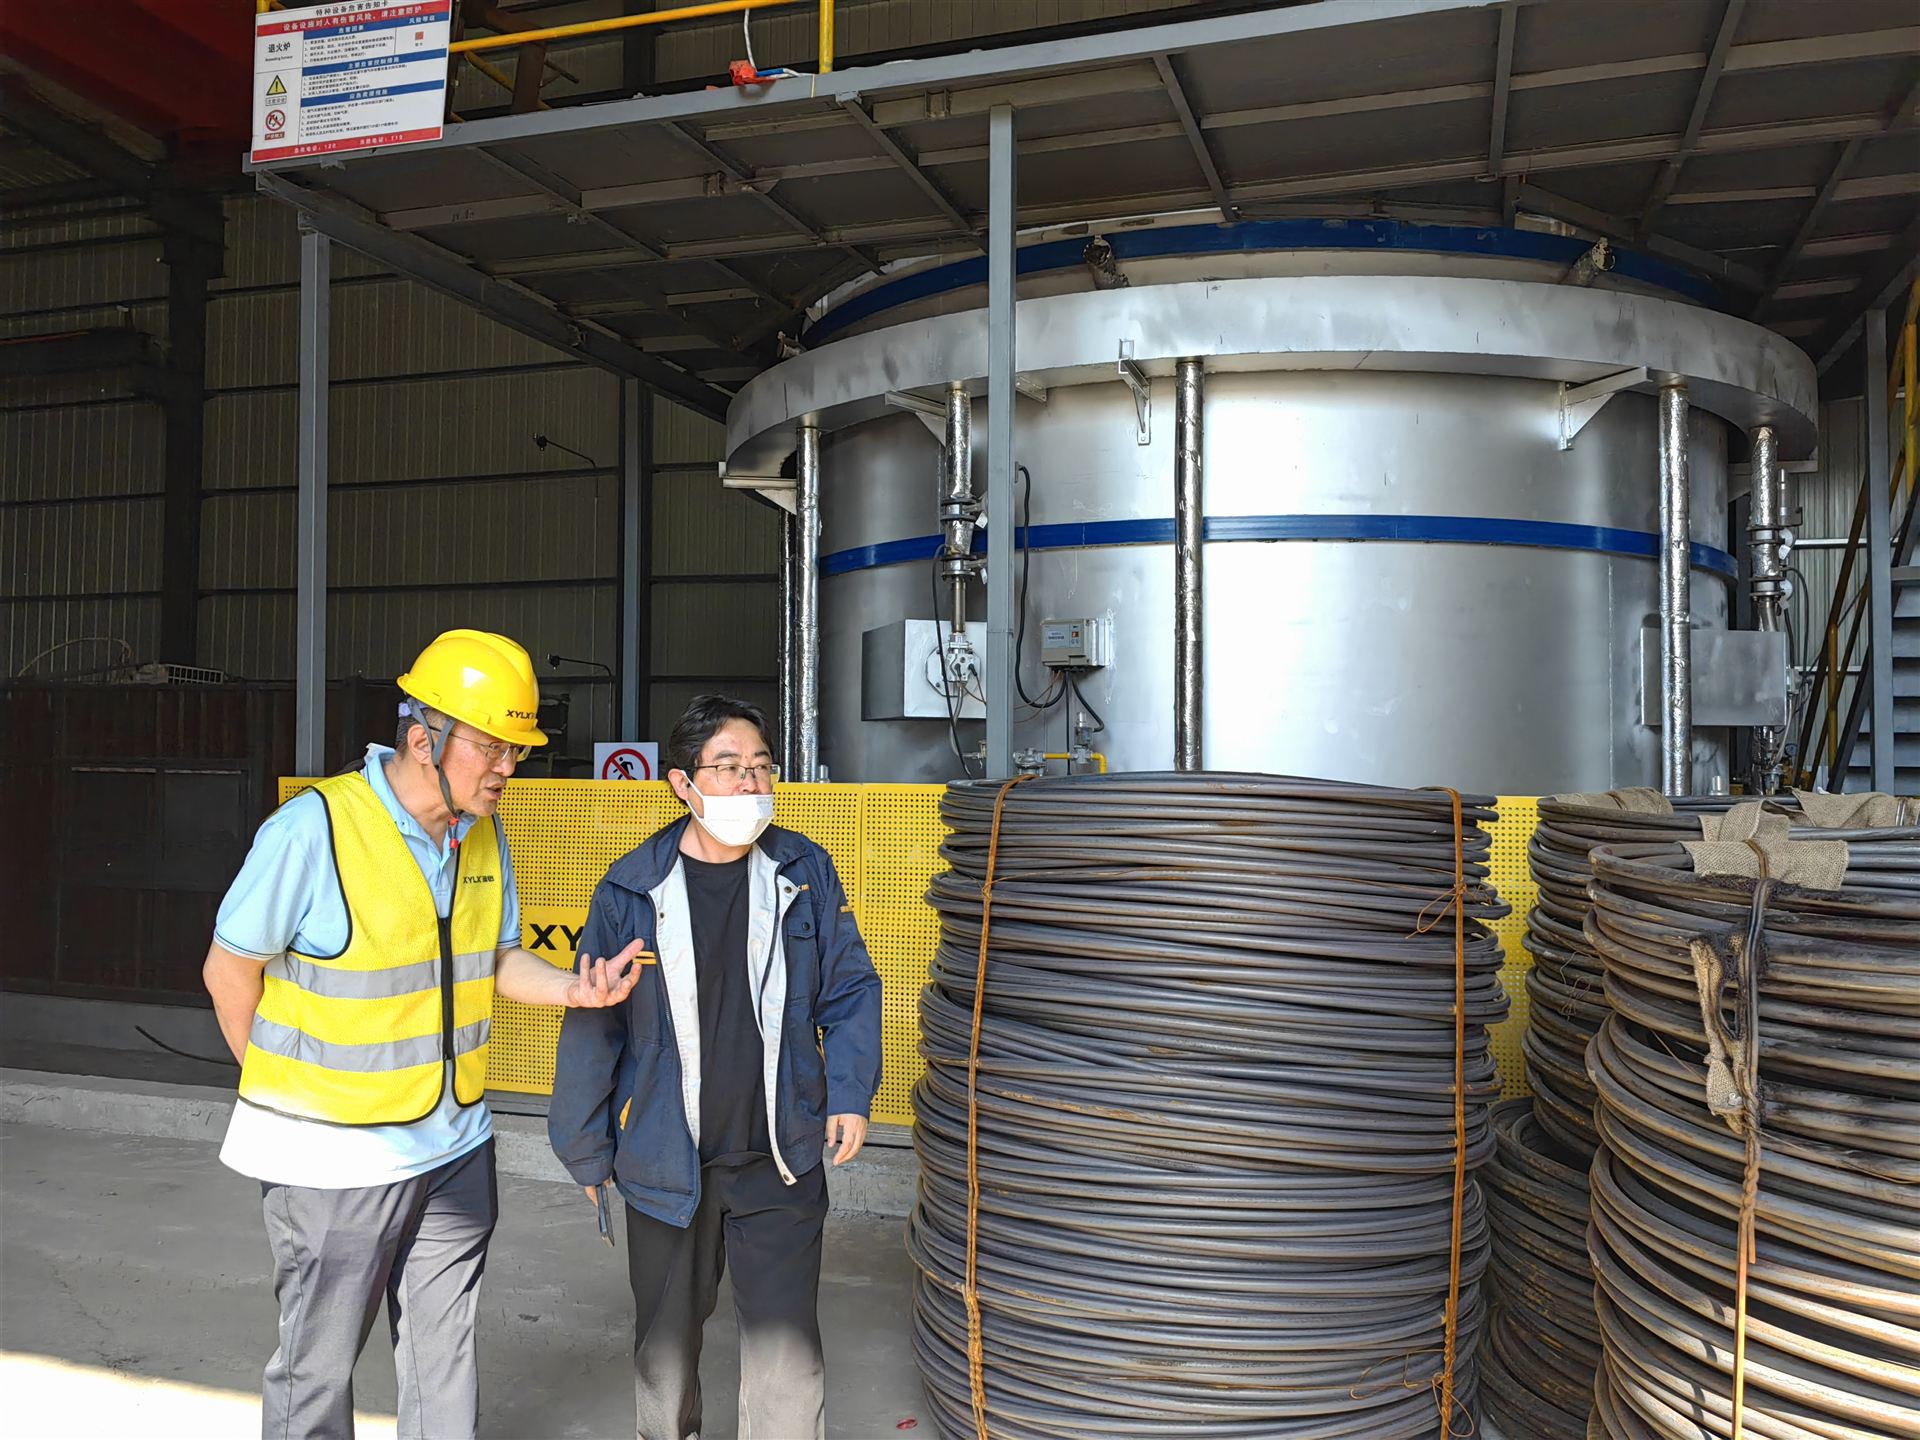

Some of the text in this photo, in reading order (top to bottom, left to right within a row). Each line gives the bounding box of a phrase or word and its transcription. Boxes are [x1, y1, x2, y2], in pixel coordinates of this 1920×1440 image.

[268, 42, 291, 53] 退火炉
[529, 924, 584, 951] XY
